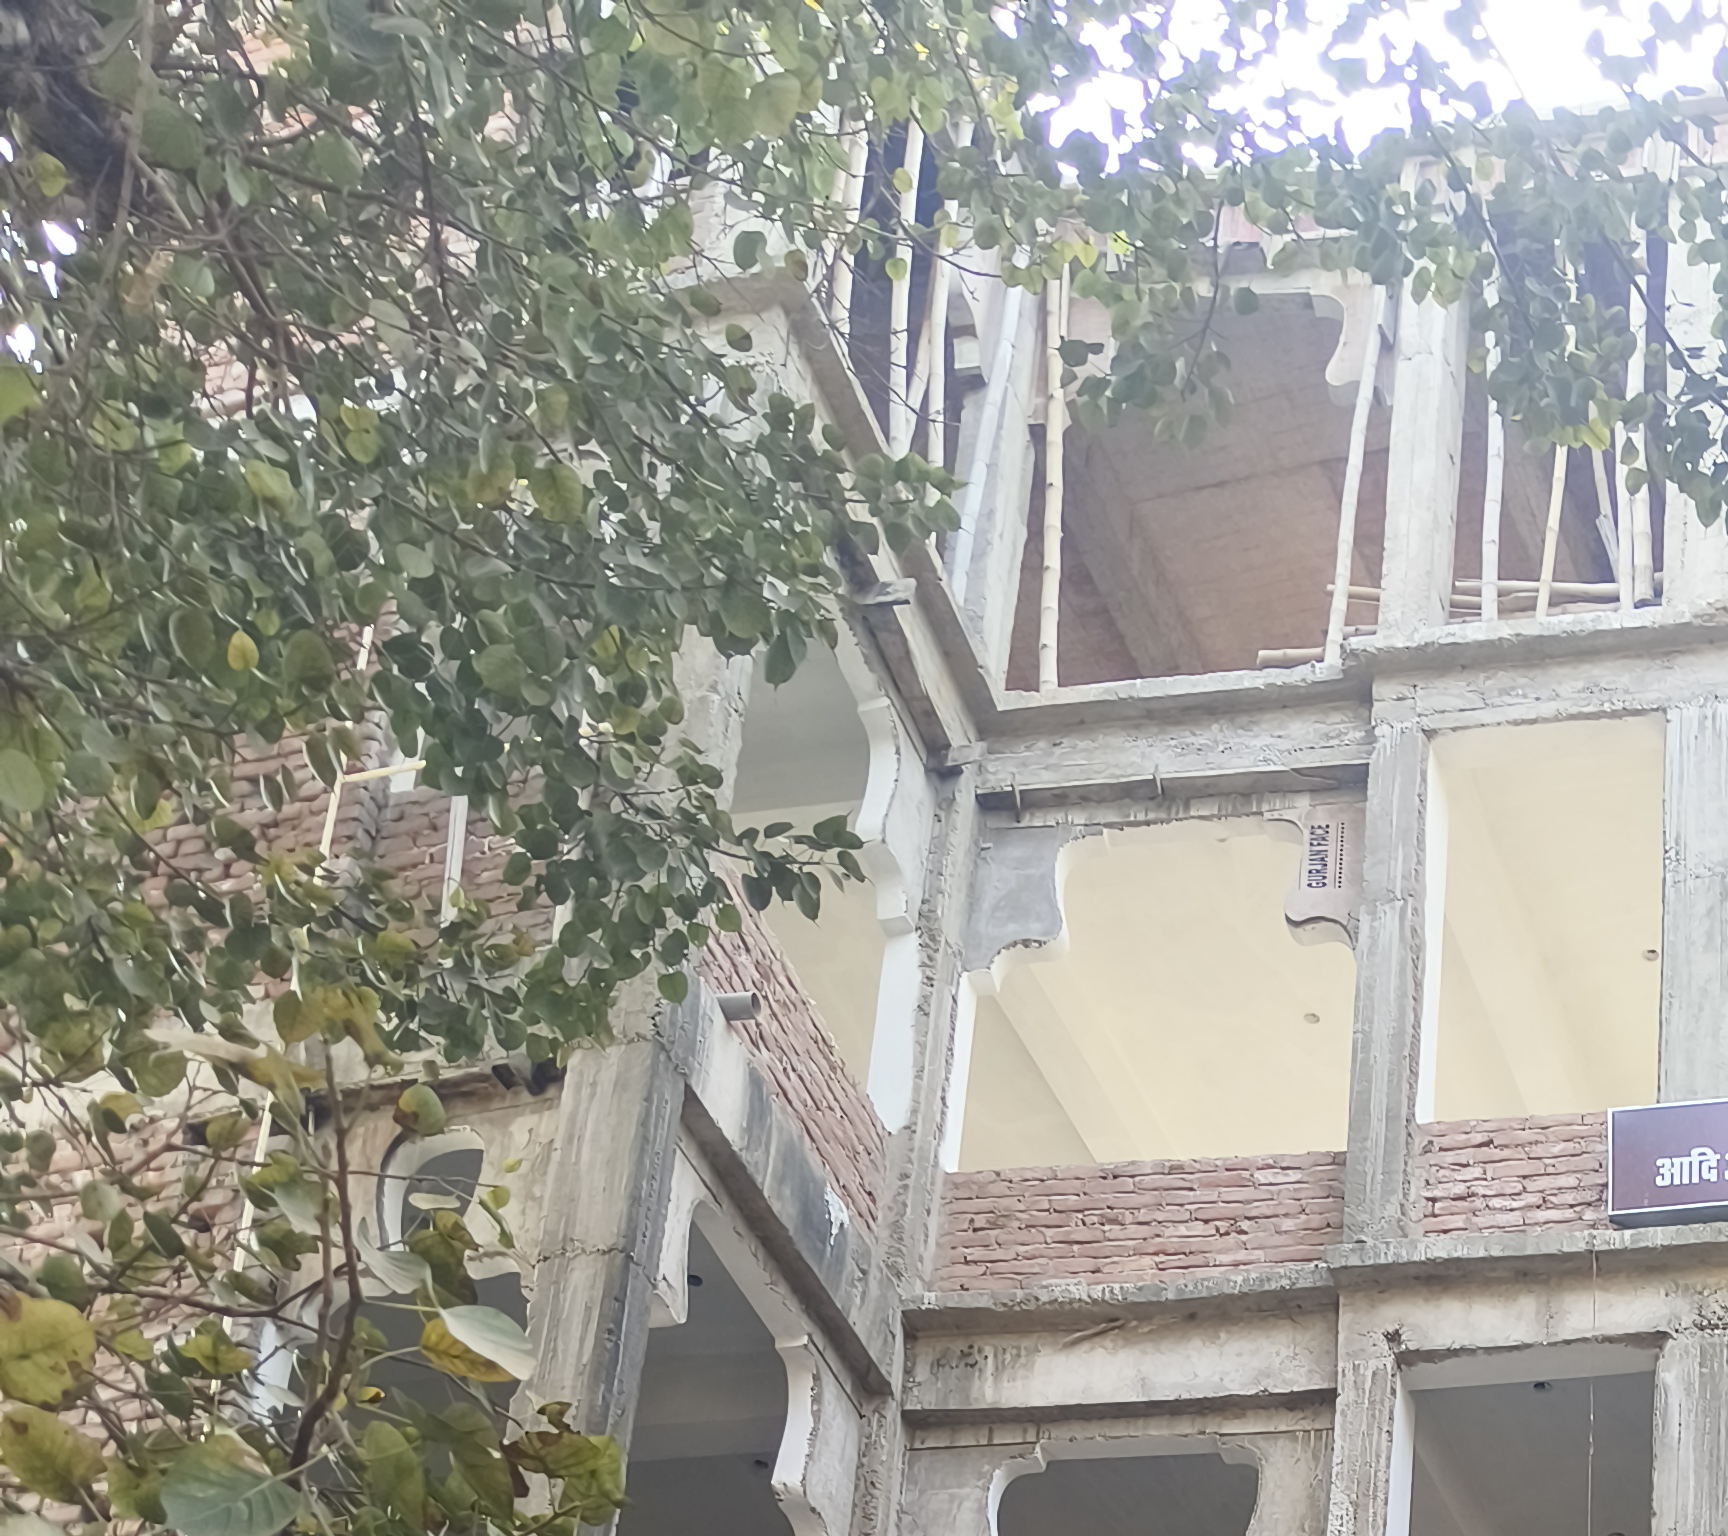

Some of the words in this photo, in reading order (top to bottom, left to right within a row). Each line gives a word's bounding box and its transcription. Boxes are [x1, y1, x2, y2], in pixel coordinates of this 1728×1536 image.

[1309, 824, 1331, 849] FACE
[1306, 849, 1328, 889] GURJAN
[1655, 1147, 1720, 1187] आदि
